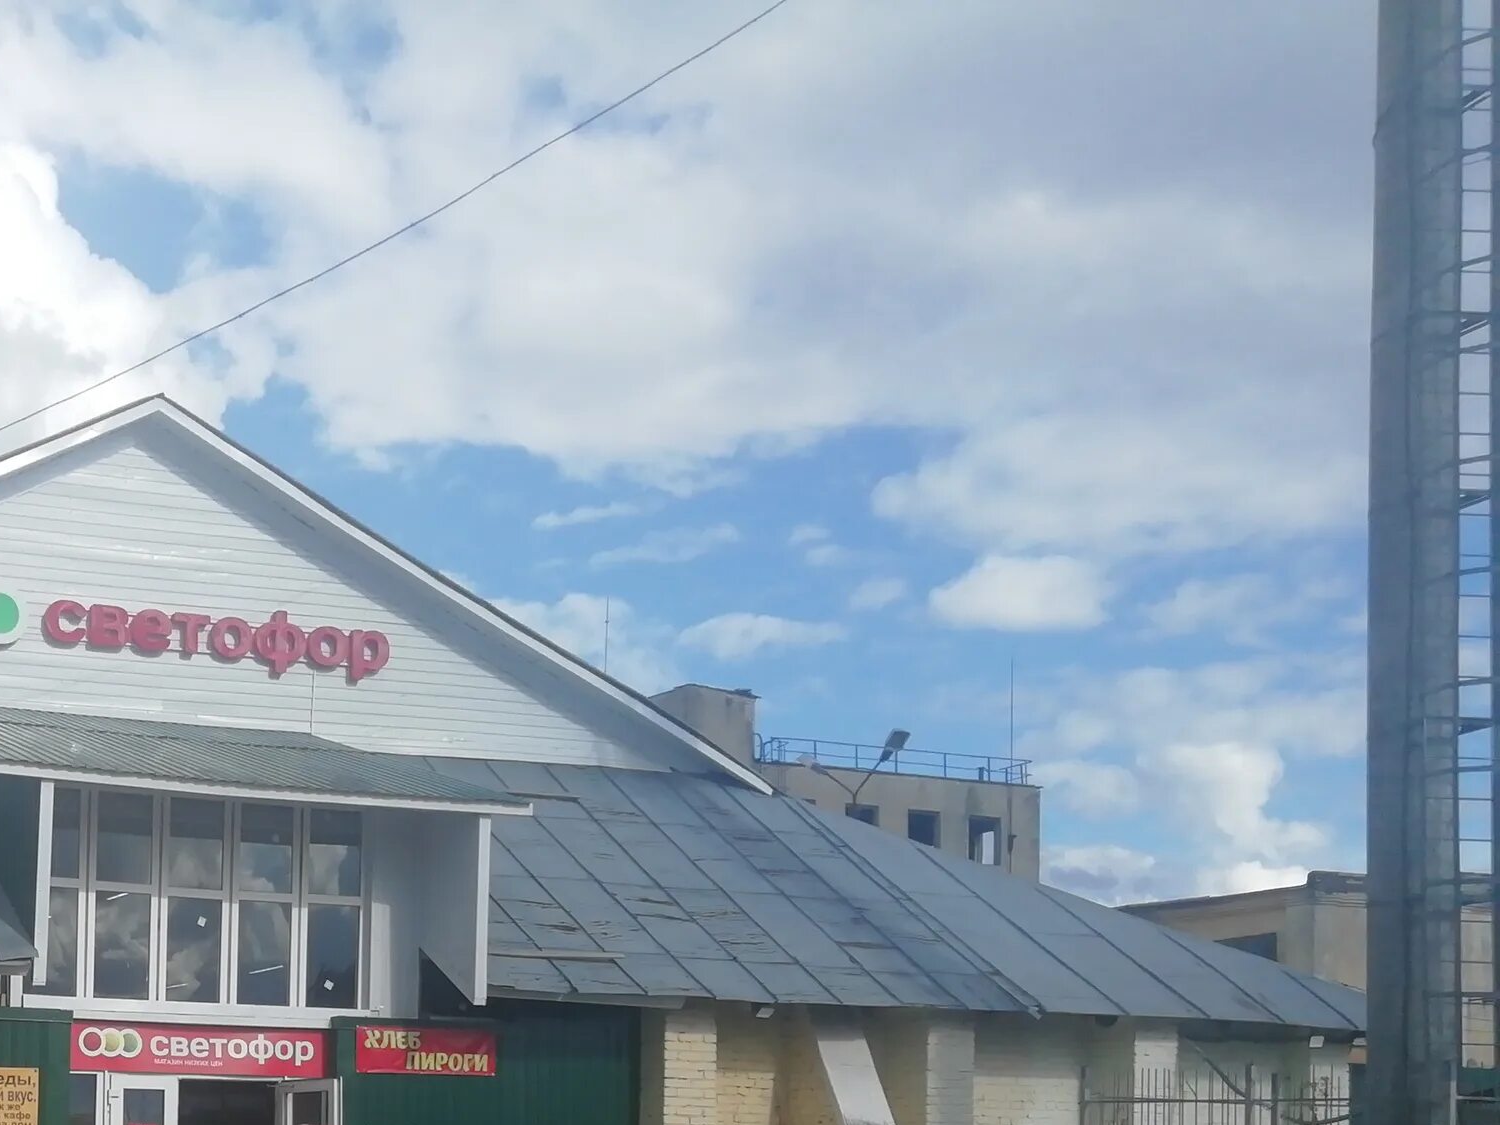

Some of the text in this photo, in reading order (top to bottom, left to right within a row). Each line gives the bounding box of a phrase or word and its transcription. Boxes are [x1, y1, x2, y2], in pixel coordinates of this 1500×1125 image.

[42, 599, 390, 684] светофор
[364, 1030, 421, 1049] ХЛЕБ
[150, 1034, 314, 1066] светофор
[406, 1051, 488, 1072] ПИРОГИ
[8, 1091, 36, 1105] вкус.
[8, 1103, 21, 1111] же
[4, 1111, 31, 1121] кафе
